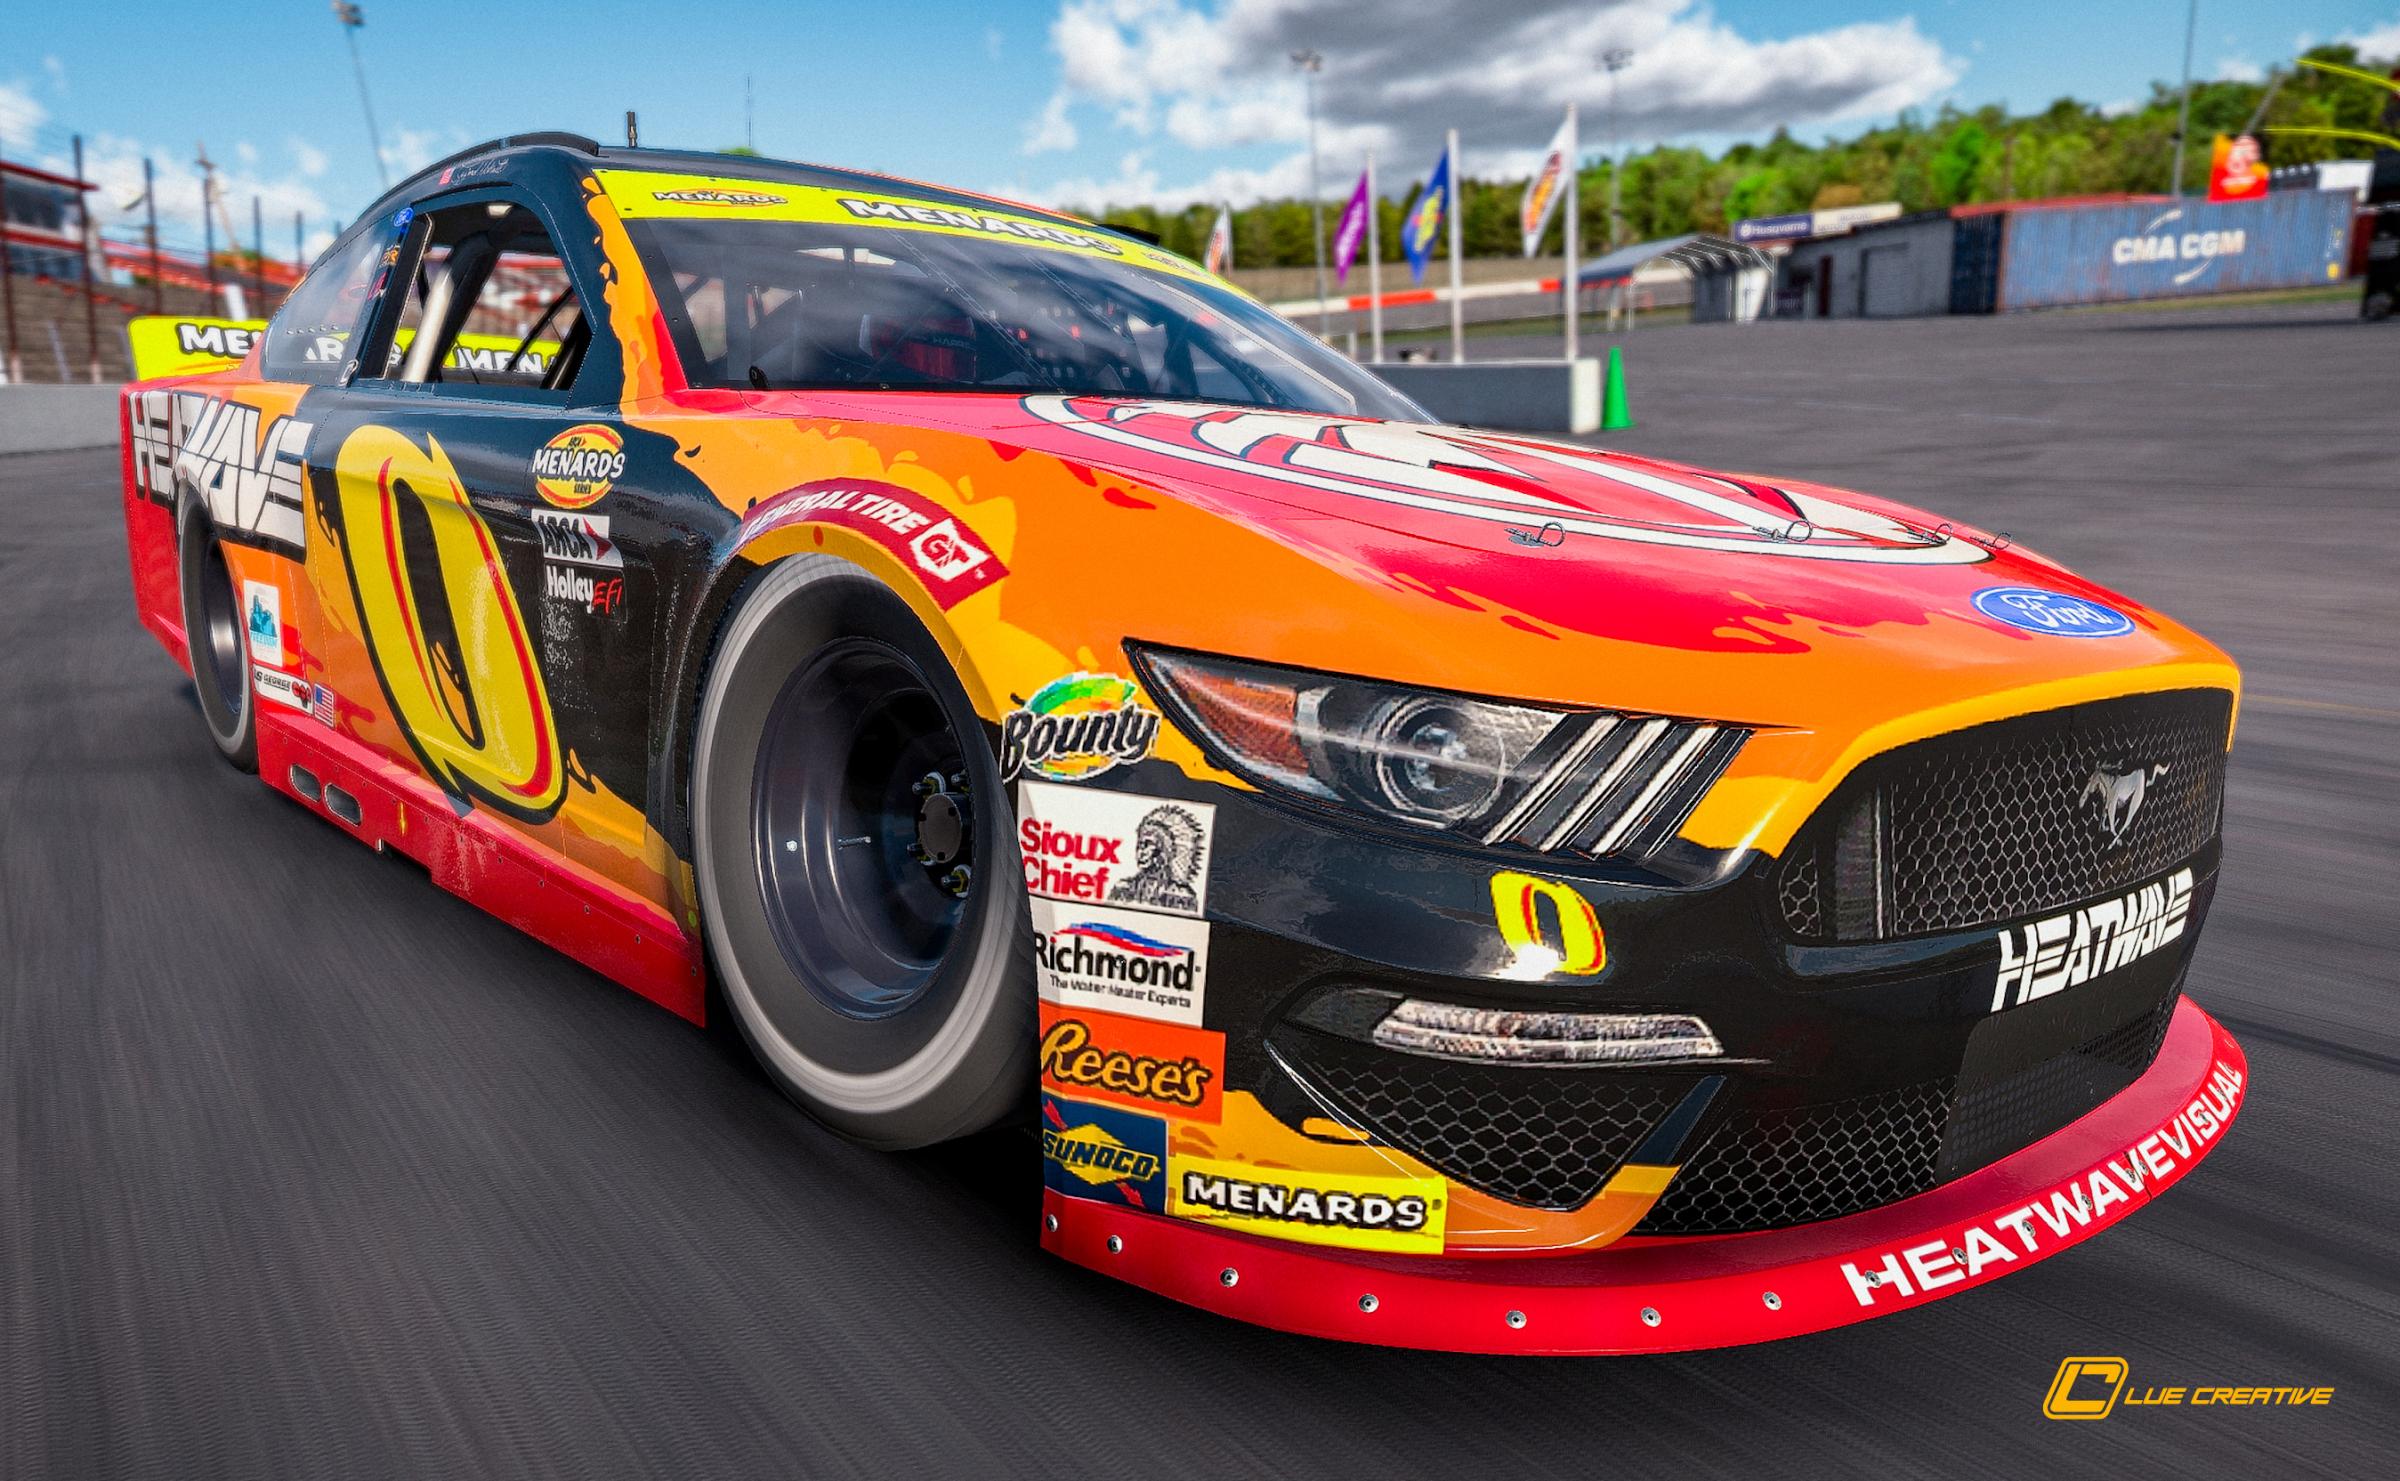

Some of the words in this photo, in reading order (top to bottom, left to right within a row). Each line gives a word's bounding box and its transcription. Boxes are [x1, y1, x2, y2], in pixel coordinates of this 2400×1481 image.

[652, 191, 788, 204] MENARDS
[837, 199, 1124, 256] MENARDS
[2113, 235, 2176, 265] CMA
[2180, 230, 2246, 259] CGM
[532, 448, 626, 479] MENARDS
[538, 514, 593, 560] ARCA
[847, 493, 932, 536] TIRE
[546, 565, 593, 614] Holley
[2000, 594, 2113, 628] Ford
[336, 425, 565, 818] 0
[1001, 704, 1159, 782] Bounty
[1021, 818, 1121, 865] Sioux
[1024, 856, 1110, 900] Chief
[1489, 869, 1608, 981] 0
[1990, 867, 2194, 1013] HEATWAVE
[1034, 932, 1194, 992] Richmond
[1050, 974, 1068, 989] The
[1070, 978, 1106, 996] Water
[1147, 989, 1192, 1009] Experts
[1041, 1020, 1211, 1104] Reese's
[1043, 1133, 1155, 1178] SUNOCO
[1186, 1173, 1427, 1229] MENARDS
[1840, 1061, 2243, 1307] HEATWAVEVISUAL
